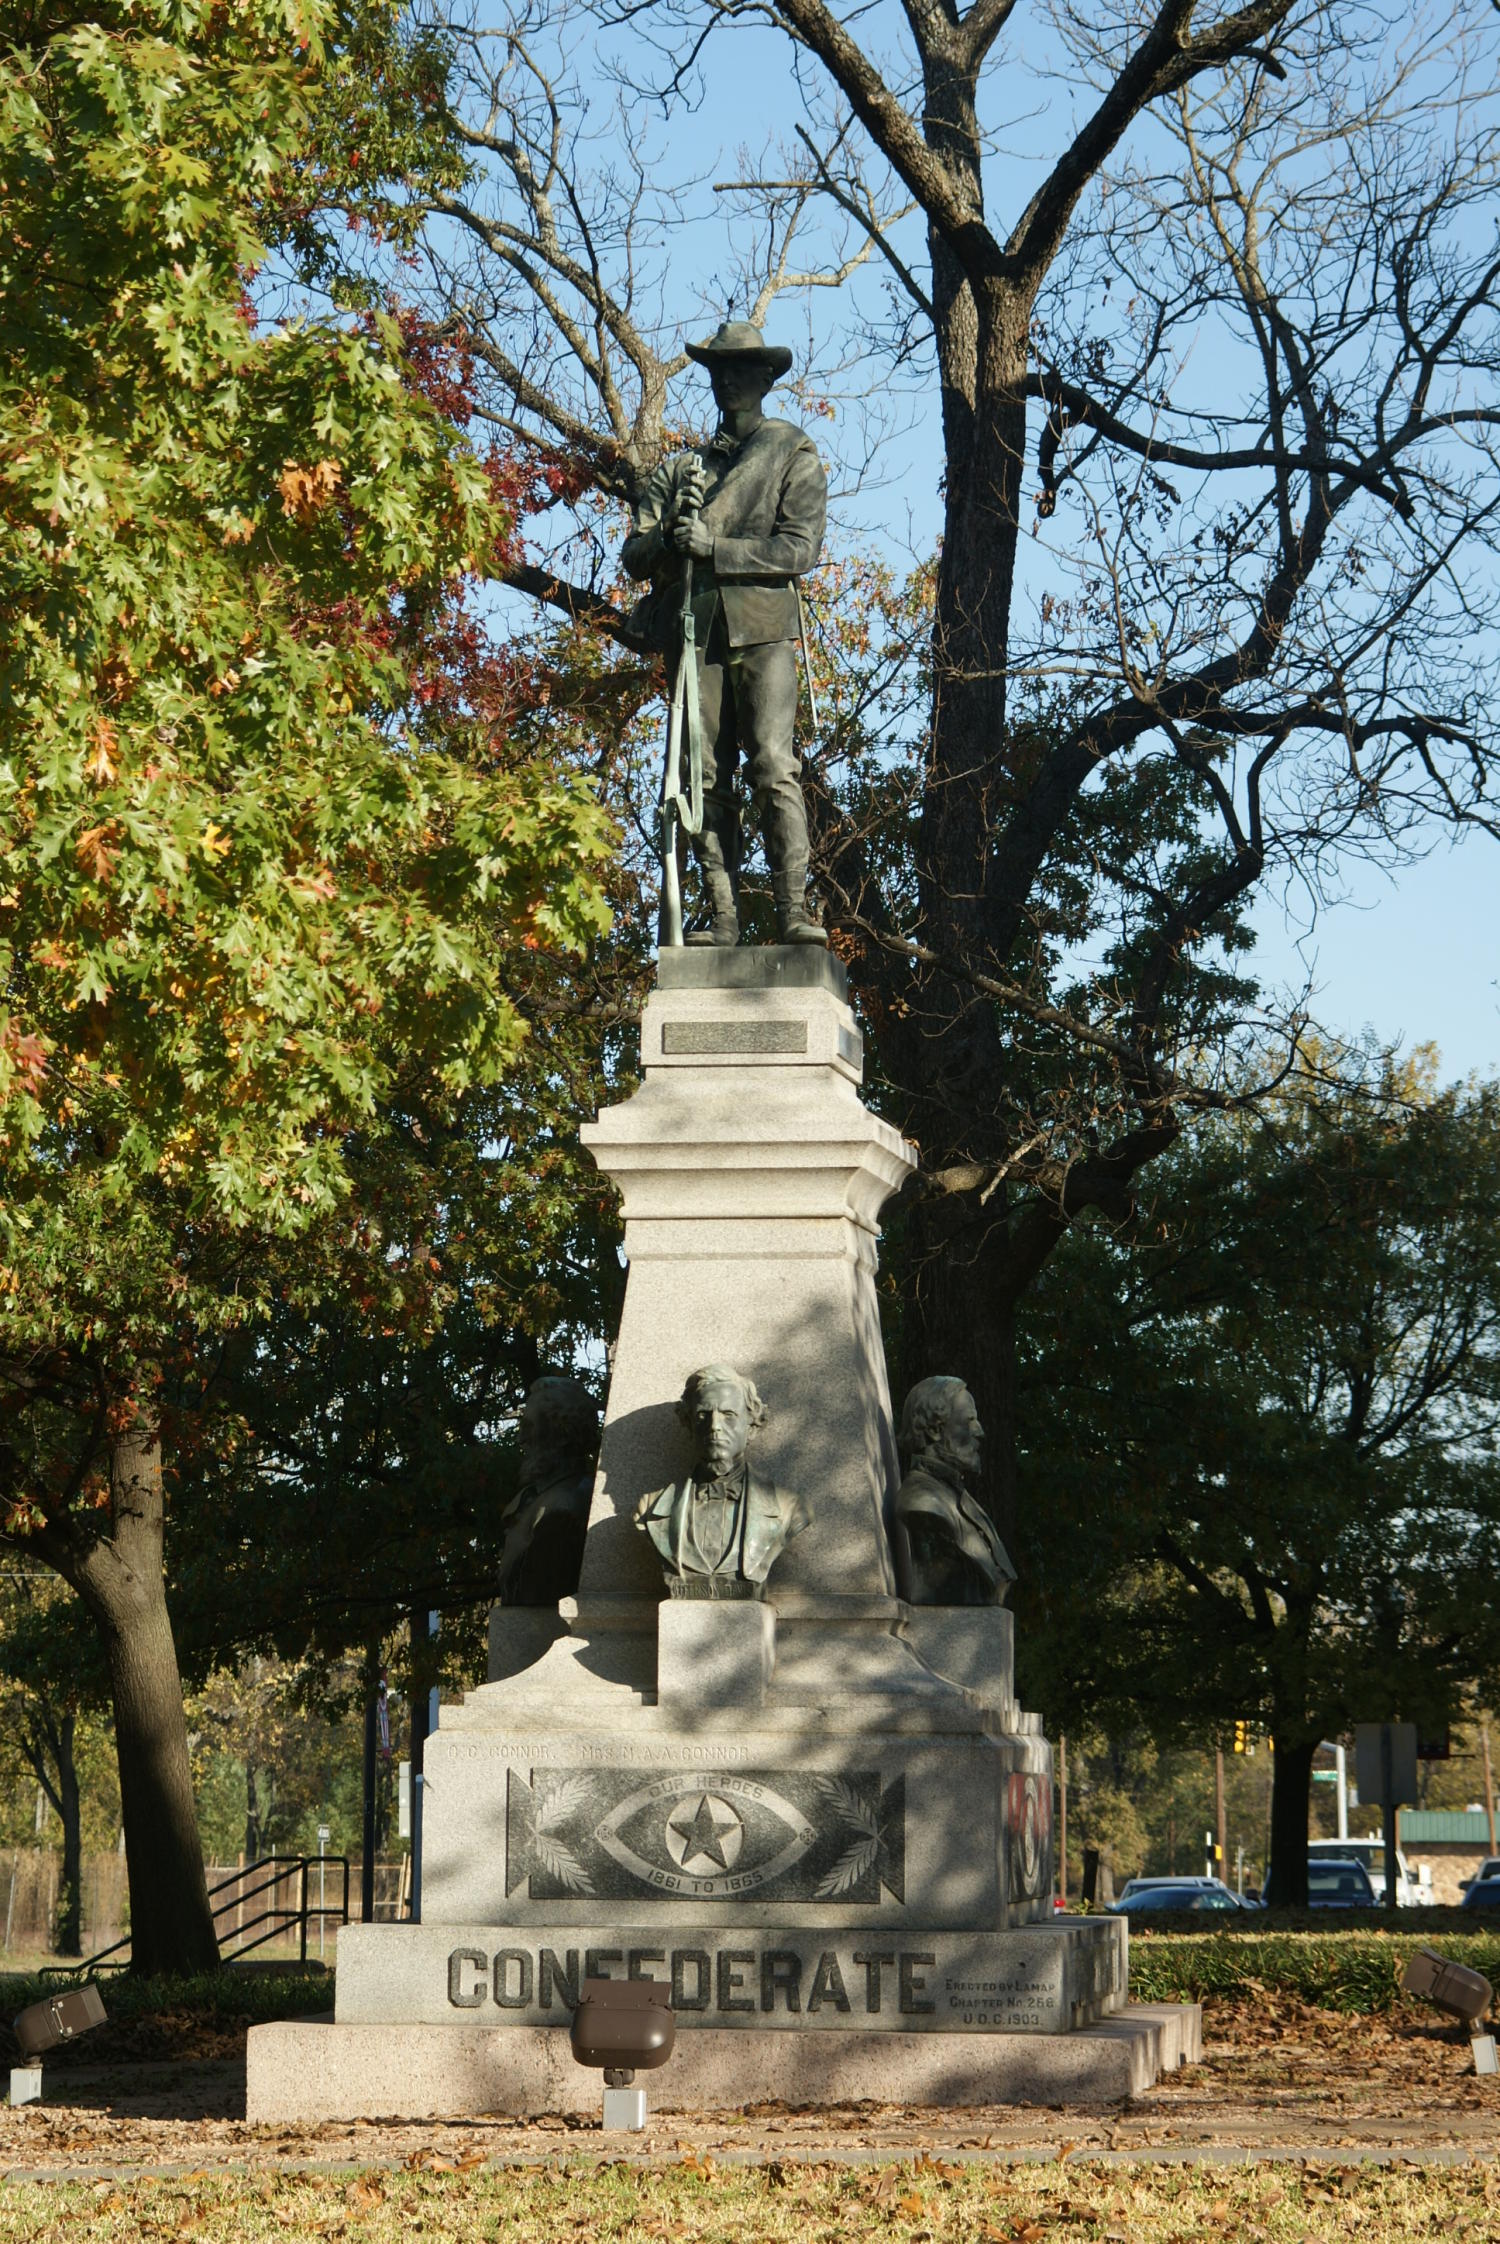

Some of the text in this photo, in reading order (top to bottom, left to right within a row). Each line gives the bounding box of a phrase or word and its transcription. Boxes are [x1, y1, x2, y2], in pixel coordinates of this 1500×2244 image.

[649, 1775, 765, 1799] OUR HEROES
[647, 1869, 765, 1893] 1861 TO 1865
